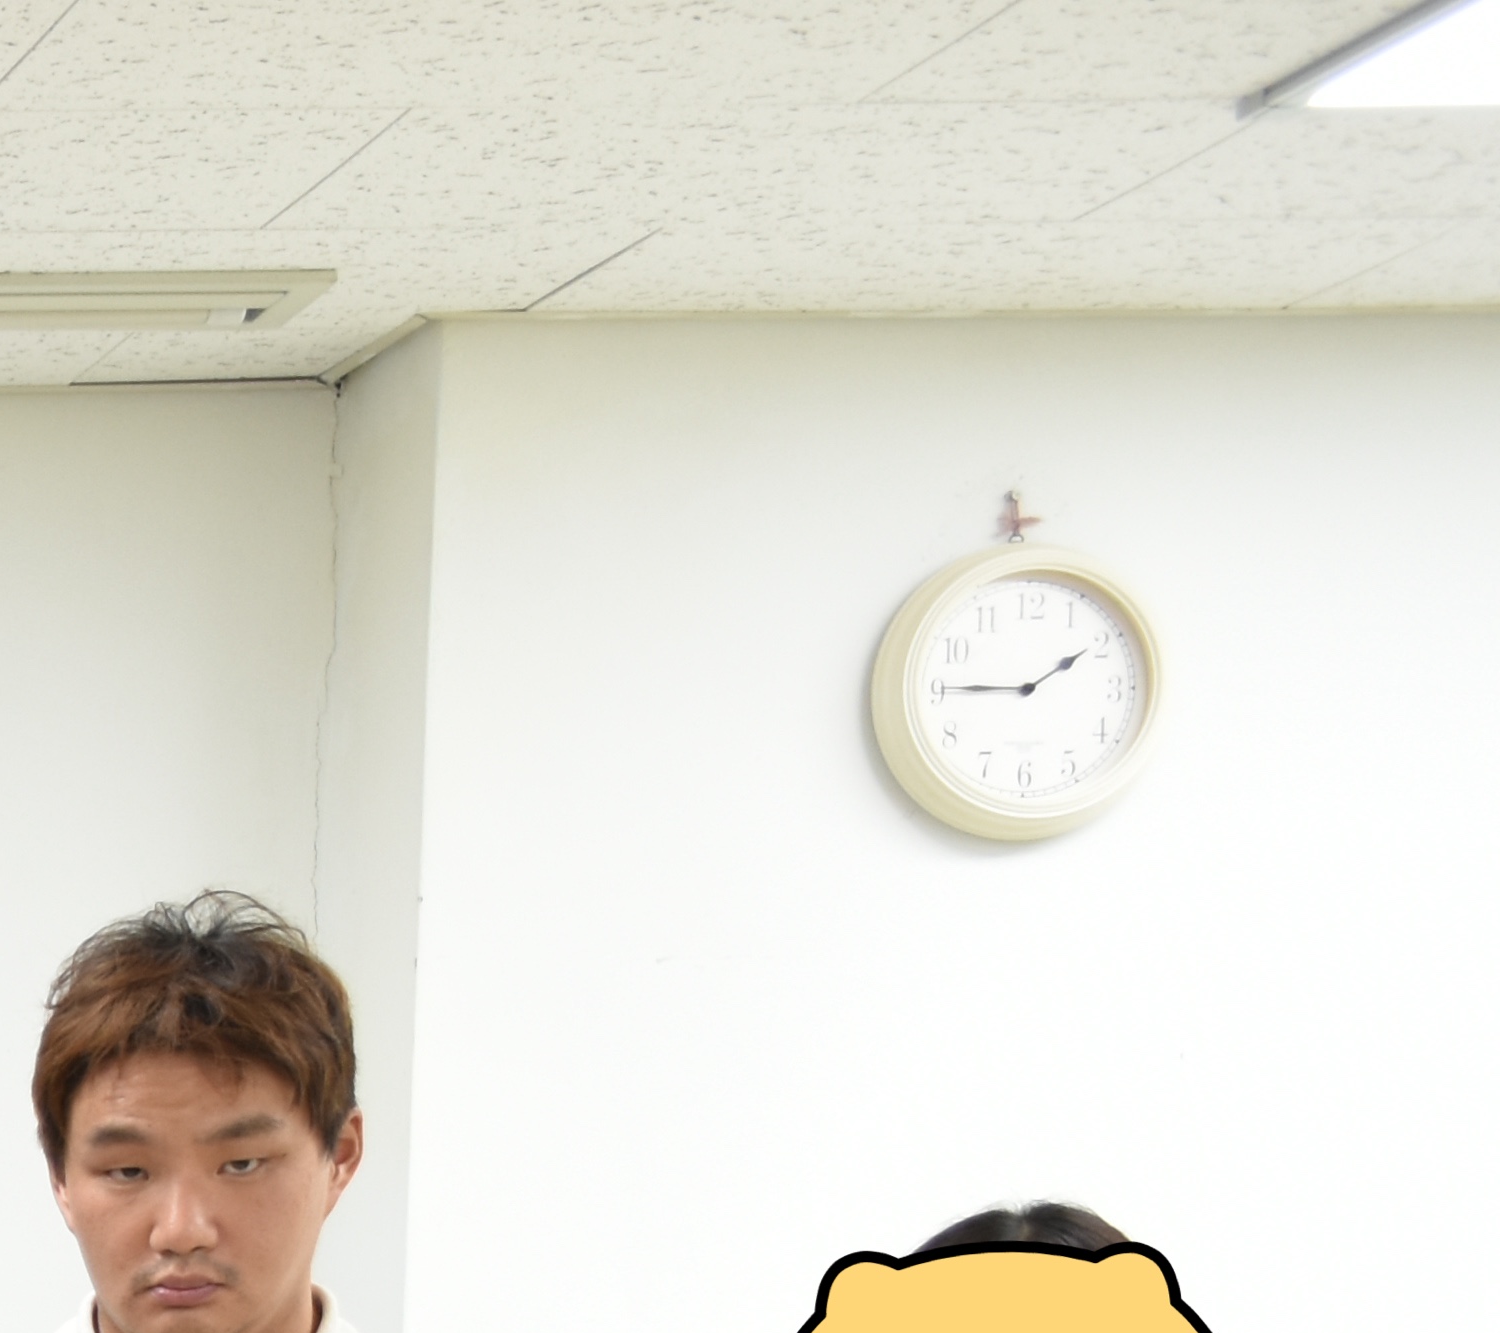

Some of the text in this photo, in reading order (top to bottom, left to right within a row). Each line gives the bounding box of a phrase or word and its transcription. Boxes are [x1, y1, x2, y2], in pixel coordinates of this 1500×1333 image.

[977, 606, 996, 633] 11
[1018, 593, 1045, 620] 12
[944, 637, 969, 664] 10
[1093, 631, 1110, 659] 2
[930, 678, 945, 705] 9
[1106, 675, 1122, 704] 3
[942, 721, 958, 748] 8
[1092, 716, 1109, 744] 4
[978, 752, 992, 779] 7
[1017, 761, 1032, 789] 6
[1060, 751, 1076, 778] 5
